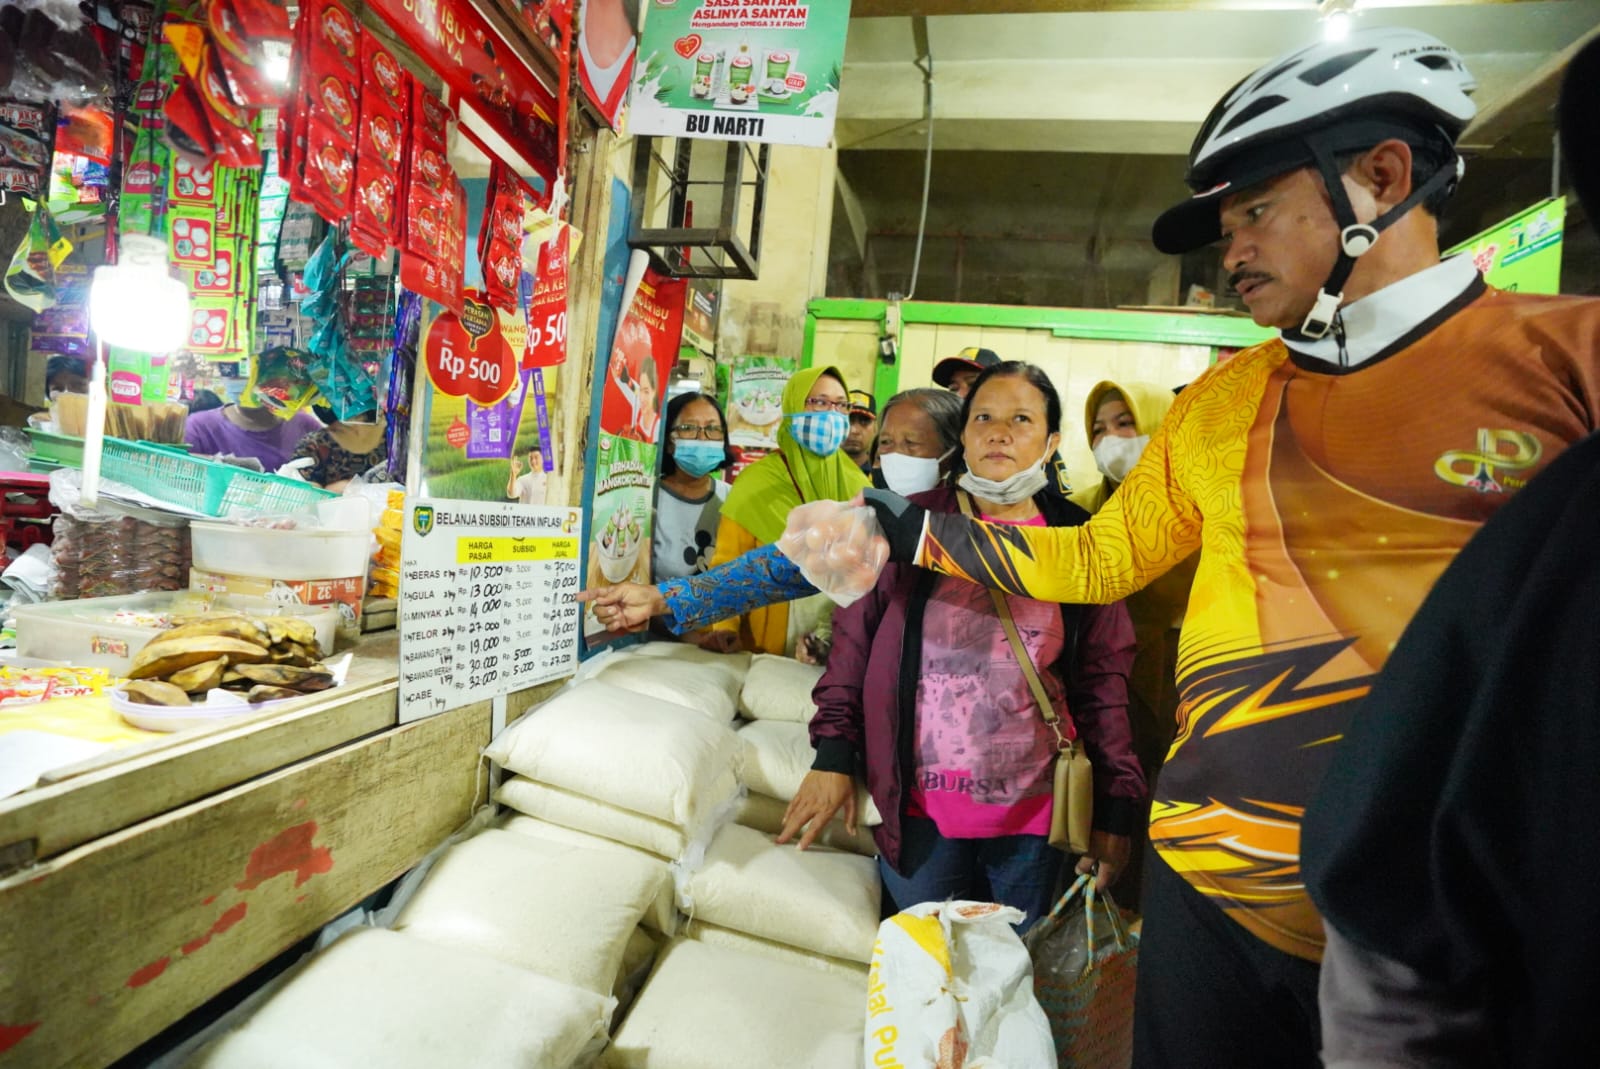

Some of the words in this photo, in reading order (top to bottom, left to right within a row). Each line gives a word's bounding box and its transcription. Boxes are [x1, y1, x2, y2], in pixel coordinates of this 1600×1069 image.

[693, 8, 748, 20] ASLINYA
[751, 8, 807, 19] SANTAN
[686, 114, 710, 133] BU
[713, 116, 764, 136] NARTI
[440, 346, 465, 380] Rp
[468, 357, 500, 384] 500
[436, 512, 477, 525] BELANJA
[478, 514, 510, 526] SUBSIDI
[512, 516, 536, 527] TEKAN
[537, 516, 562, 528] INFLASI
[468, 542, 493, 550] HARGA
[512, 545, 536, 553] SUBSIDI
[468, 552, 492, 560] PASAR
[412, 570, 440, 580] BERAS
[470, 566, 503, 582] 10.500
[318, 586, 332, 600] 32
[412, 590, 434, 600] GULA
[411, 610, 442, 620] MINYAK
[412, 629, 438, 640] TELOR
[470, 636, 500, 654] 19.000
[410, 650, 434, 661] BAWANG
[410, 669, 433, 680] BAWANG
[410, 689, 432, 702] CABE
[924, 770, 1008, 796] BURSA
